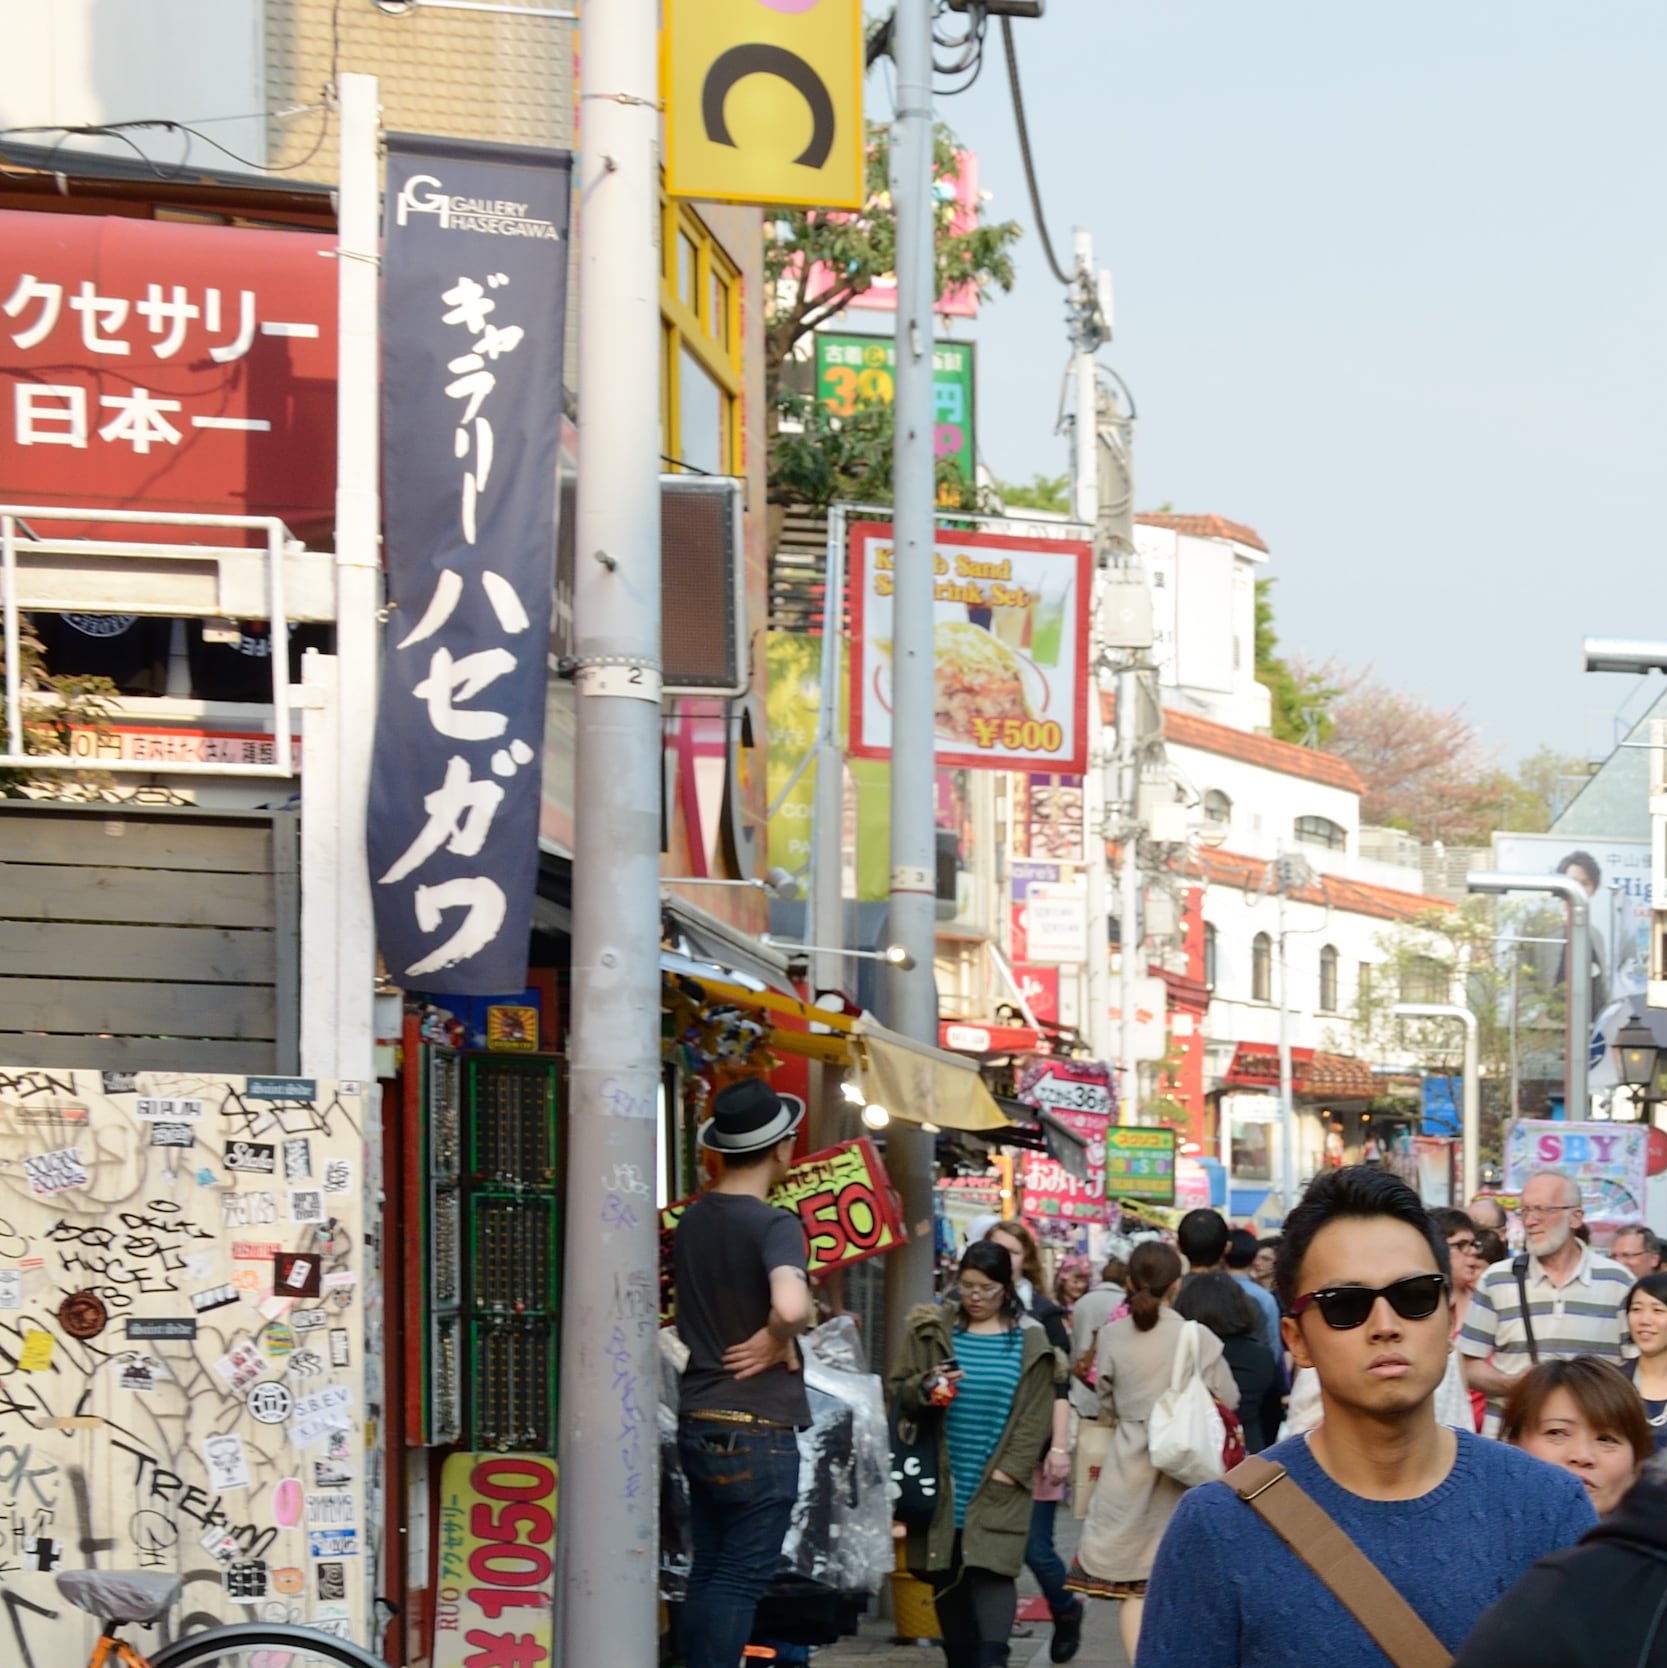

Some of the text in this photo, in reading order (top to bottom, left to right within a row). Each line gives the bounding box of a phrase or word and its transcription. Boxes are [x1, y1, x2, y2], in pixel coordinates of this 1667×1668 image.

[450, 196, 529, 218] GALLERY
[450, 216, 560, 241] HASEGAWA
[14, 384, 271, 454] 日本一
[955, 553, 1012, 581] Sand
[971, 717, 1063, 752] ¥500
[1538, 1135, 1619, 1162] SBY
